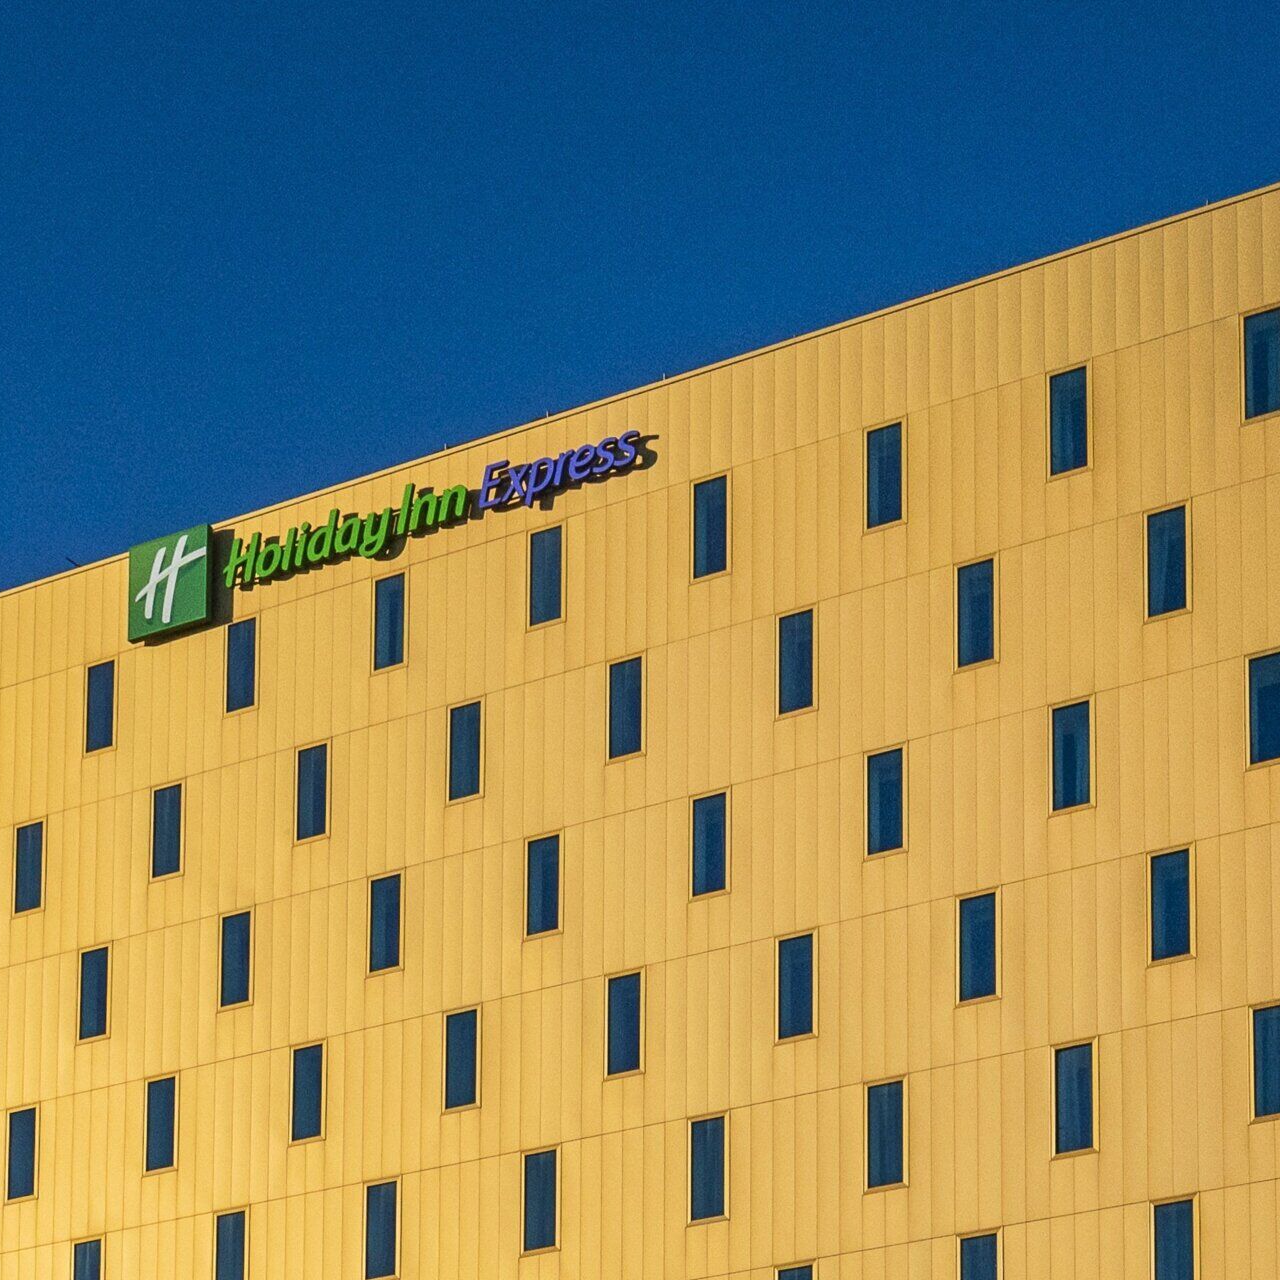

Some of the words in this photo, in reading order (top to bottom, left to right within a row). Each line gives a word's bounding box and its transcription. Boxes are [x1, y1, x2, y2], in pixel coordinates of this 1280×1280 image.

[223, 507, 393, 588] Holiday
[396, 483, 467, 535] Inn
[478, 430, 641, 510] Express
